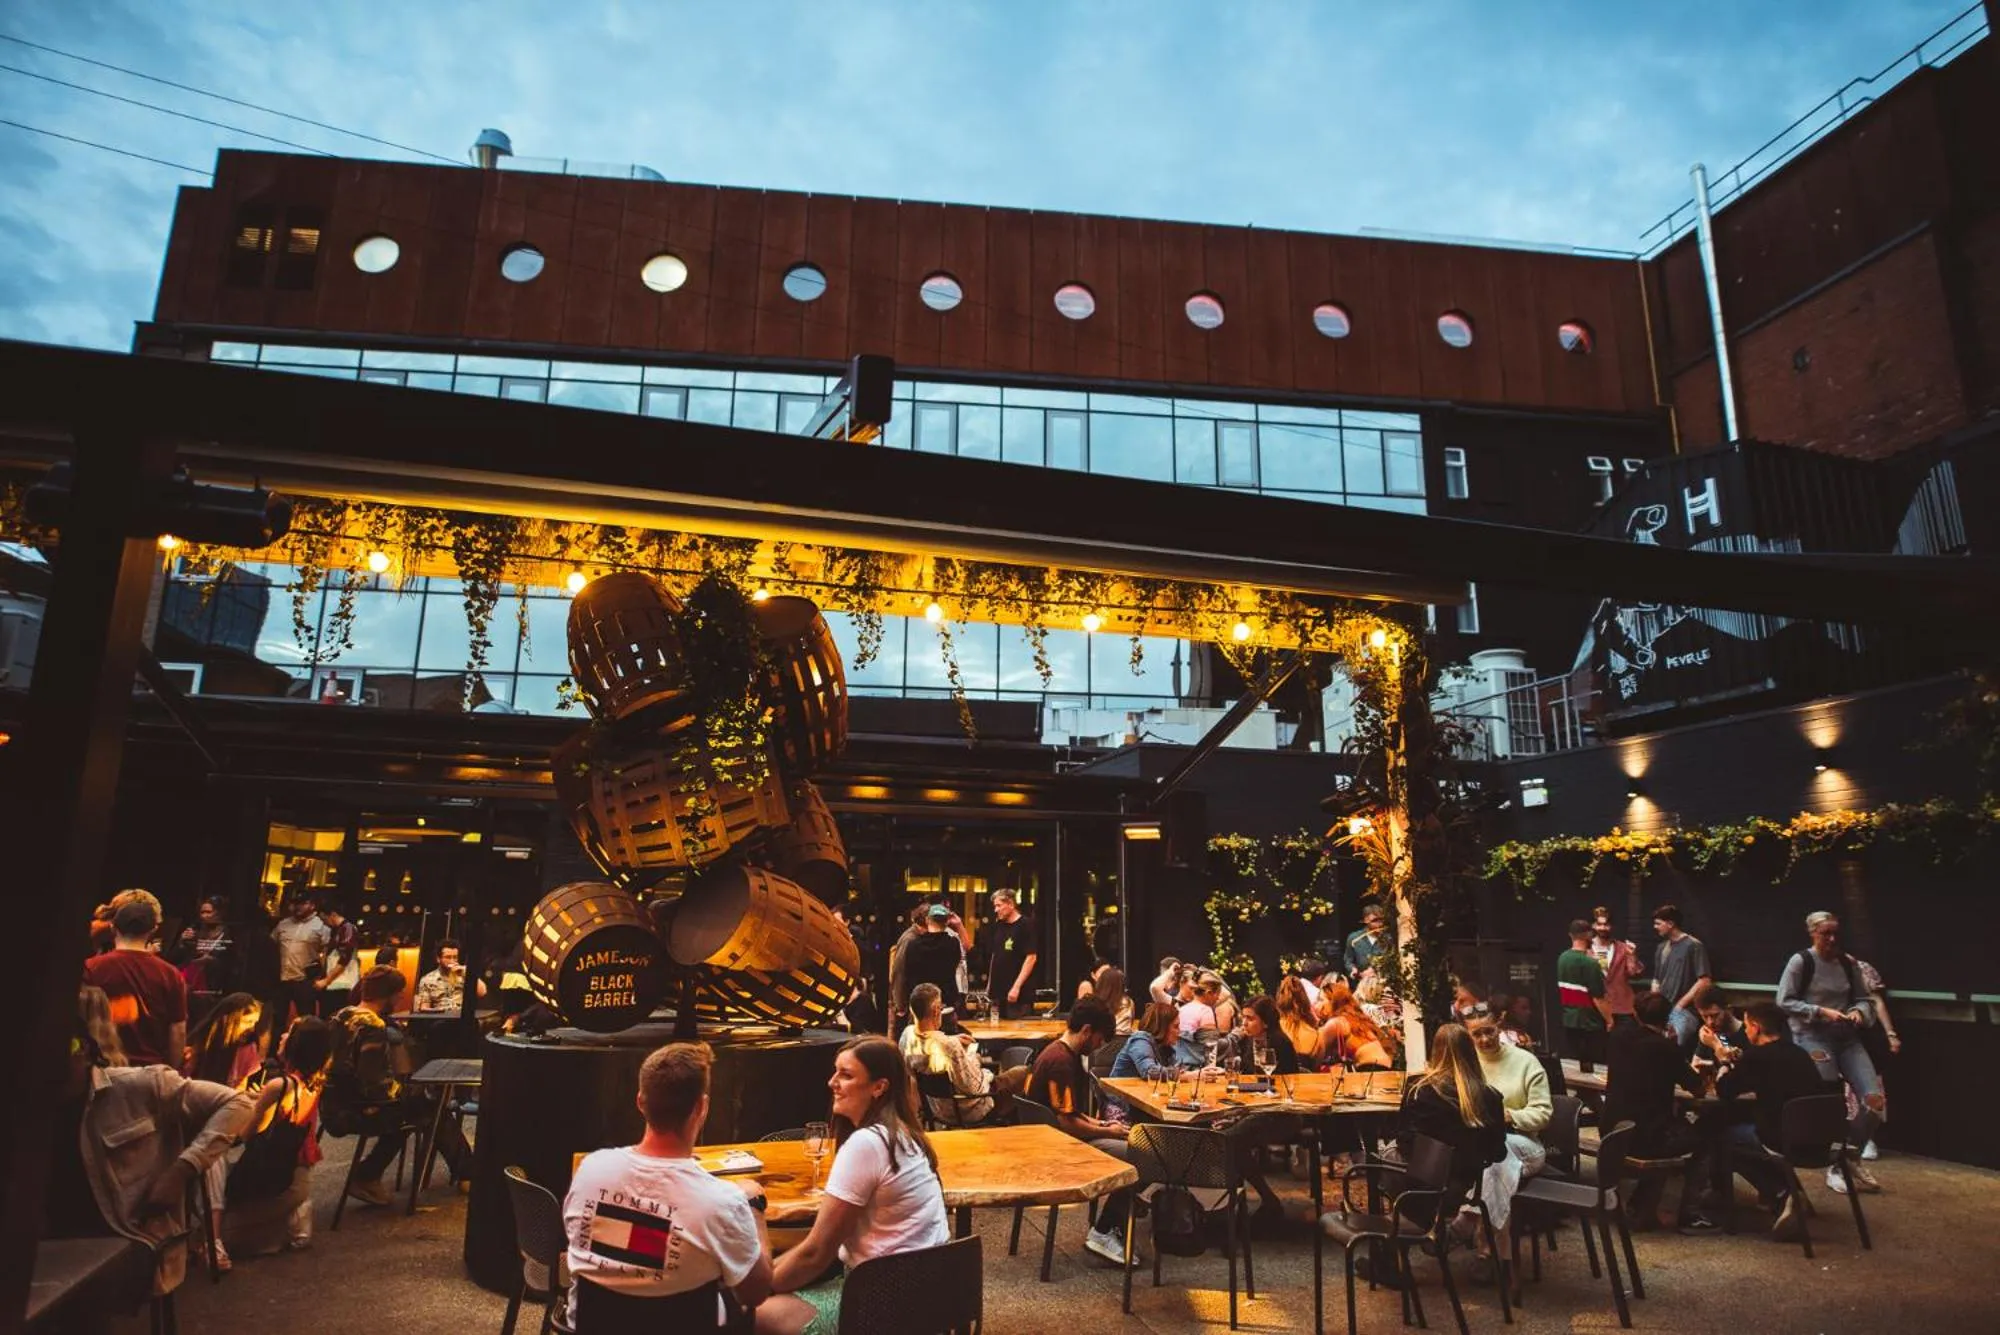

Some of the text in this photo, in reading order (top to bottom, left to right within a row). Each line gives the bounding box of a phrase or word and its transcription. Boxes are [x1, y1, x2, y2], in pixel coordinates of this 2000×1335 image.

[590, 973, 635, 991] BLACK
[583, 991, 637, 1009] BARREL
[599, 1188, 678, 1218] TOMMY
[580, 1199, 596, 1250] SINCE
[667, 1225, 683, 1271] 1985
